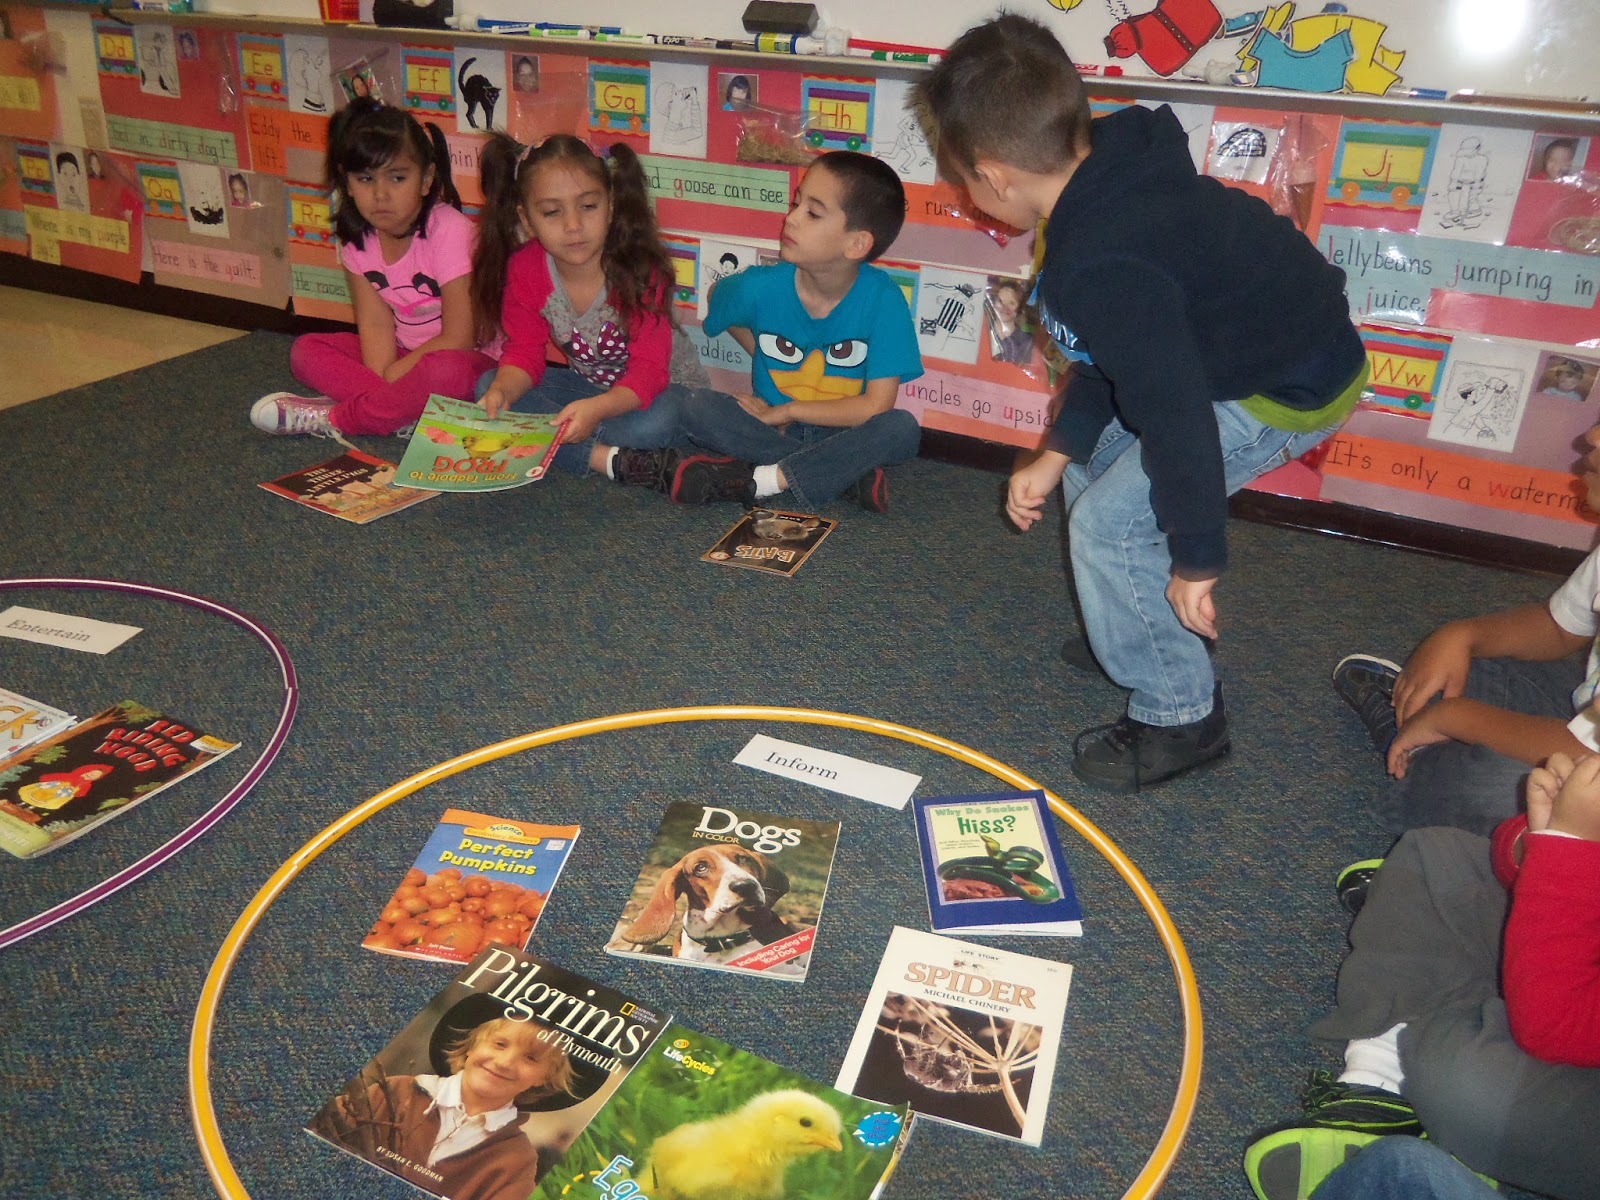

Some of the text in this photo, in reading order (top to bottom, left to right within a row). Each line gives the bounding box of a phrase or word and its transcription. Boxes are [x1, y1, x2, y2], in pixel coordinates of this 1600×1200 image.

[103, 36, 126, 57] Dd
[251, 53, 273, 76] Ee
[418, 68, 440, 90] Ff
[603, 85, 638, 117] Gg
[249, 113, 311, 144] Eddy the
[818, 101, 852, 130] Hh
[447, 144, 481, 168] hin
[1363, 149, 1394, 190] Jj
[645, 167, 784, 203] nd goose can see
[302, 204, 321, 224] Rr
[153, 246, 179, 267] Here
[188, 255, 198, 269] is
[204, 253, 218, 273] the
[1320, 235, 1593, 301] Jellybeans jumping in
[295, 271, 345, 297] He races
[1358, 286, 1426, 317] juice.
[695, 339, 742, 364] ddies
[1371, 353, 1426, 388] Ww
[905, 380, 1053, 429] uncles go upsid
[428, 471, 478, 483] Tadpole
[432, 455, 510, 475] FROG
[1327, 440, 1582, 511] It's only a waterm
[734, 545, 796, 563] BATS
[7, 619, 91, 643] Entertain
[144, 720, 195, 743] RED
[94, 741, 157, 772] HOOD
[105, 728, 187, 767] RIDING
[763, 752, 838, 780] Inform
[935, 808, 961, 816] Why
[985, 804, 1029, 813] Snakes
[489, 824, 522, 836] Science
[692, 831, 740, 844] IN COLOR
[695, 806, 802, 854] Dogs
[957, 815, 1016, 836] Hiss?
[458, 838, 534, 860] Perfect
[737, 934, 811, 966] Including Caring for
[761, 947, 797, 964] Your Dog
[978, 953, 999, 961] STORY
[904, 961, 1036, 1010] SPIDER
[459, 948, 650, 1057] Pilgrims
[924, 988, 1011, 1013] MICHAEL CHINERY
[536, 1027, 622, 1075] of Plymouth
[385, 1150, 406, 1164] SUSAN
[413, 1164, 444, 1182] GOODMAN
[593, 1155, 649, 1200] Eg
